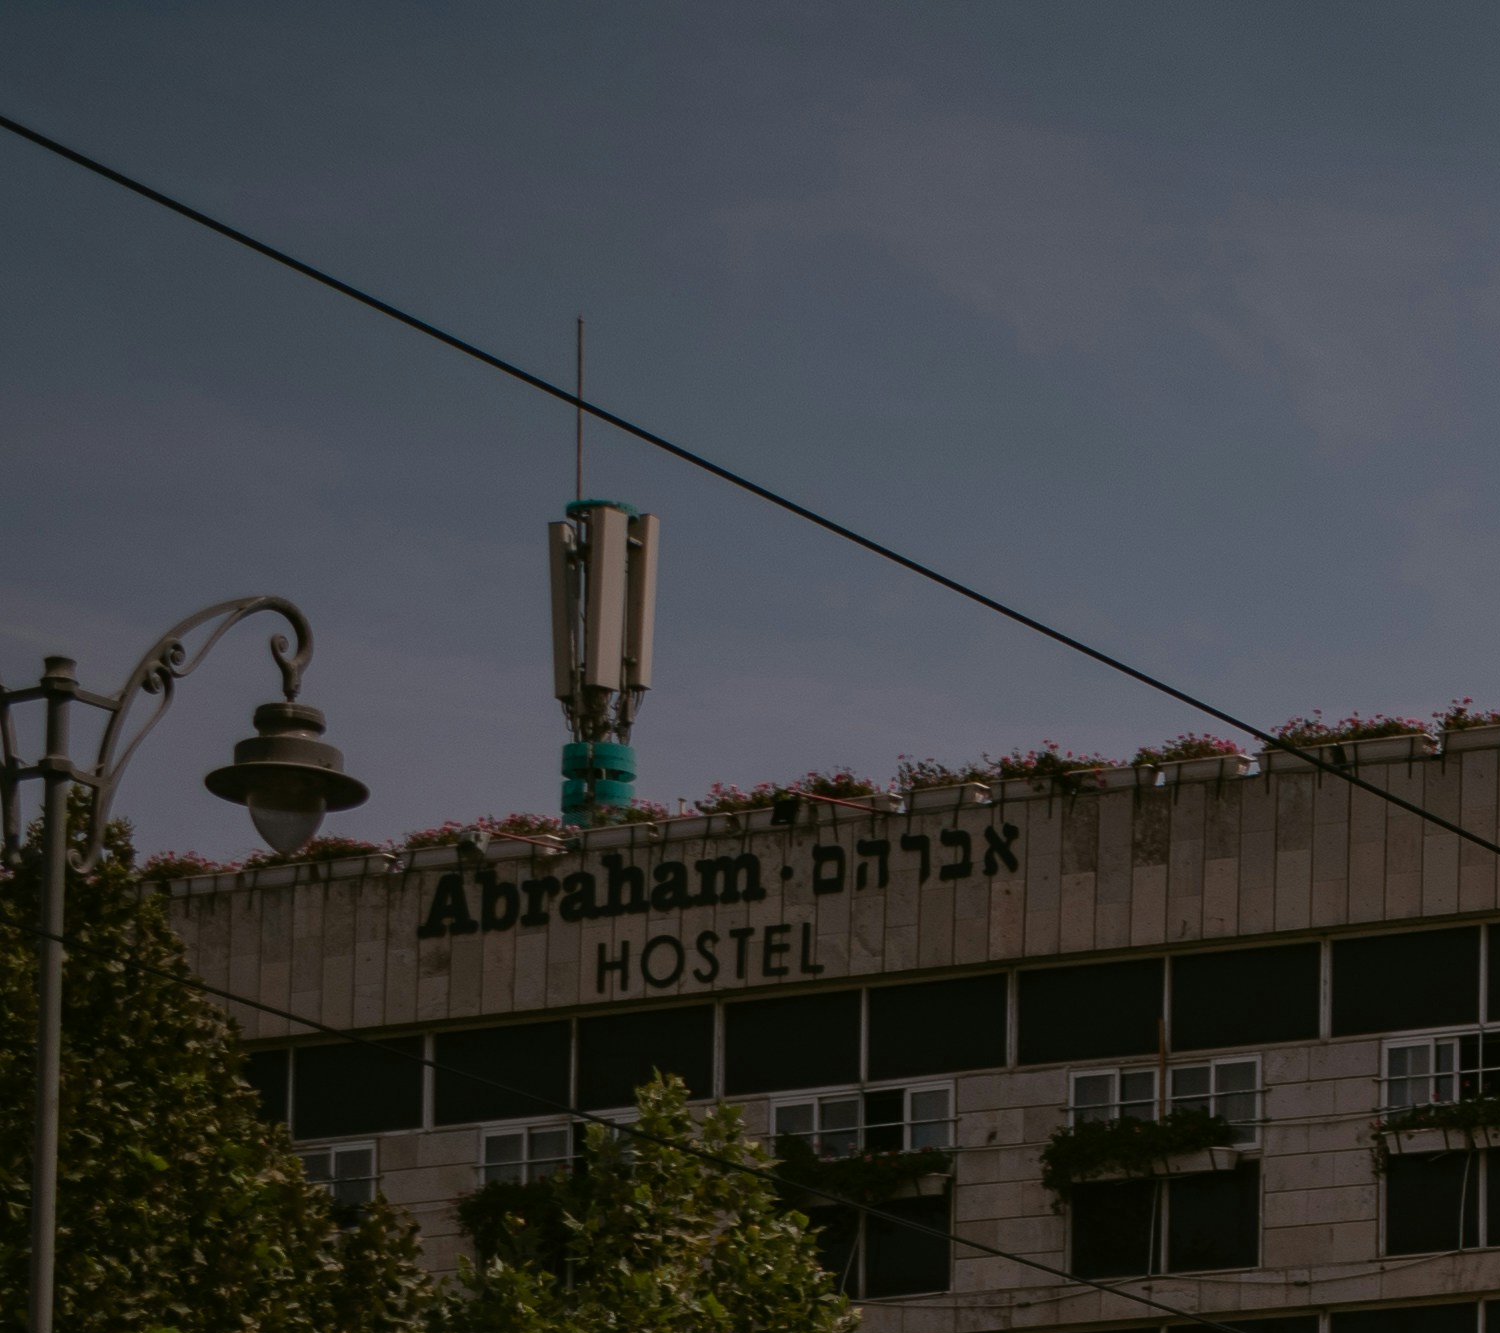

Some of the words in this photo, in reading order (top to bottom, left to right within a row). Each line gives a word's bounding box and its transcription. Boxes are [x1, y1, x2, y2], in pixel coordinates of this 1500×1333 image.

[417, 851, 767, 939] Abraham
[812, 822, 1020, 895] אברהם
[596, 921, 825, 993] HOSTEL
